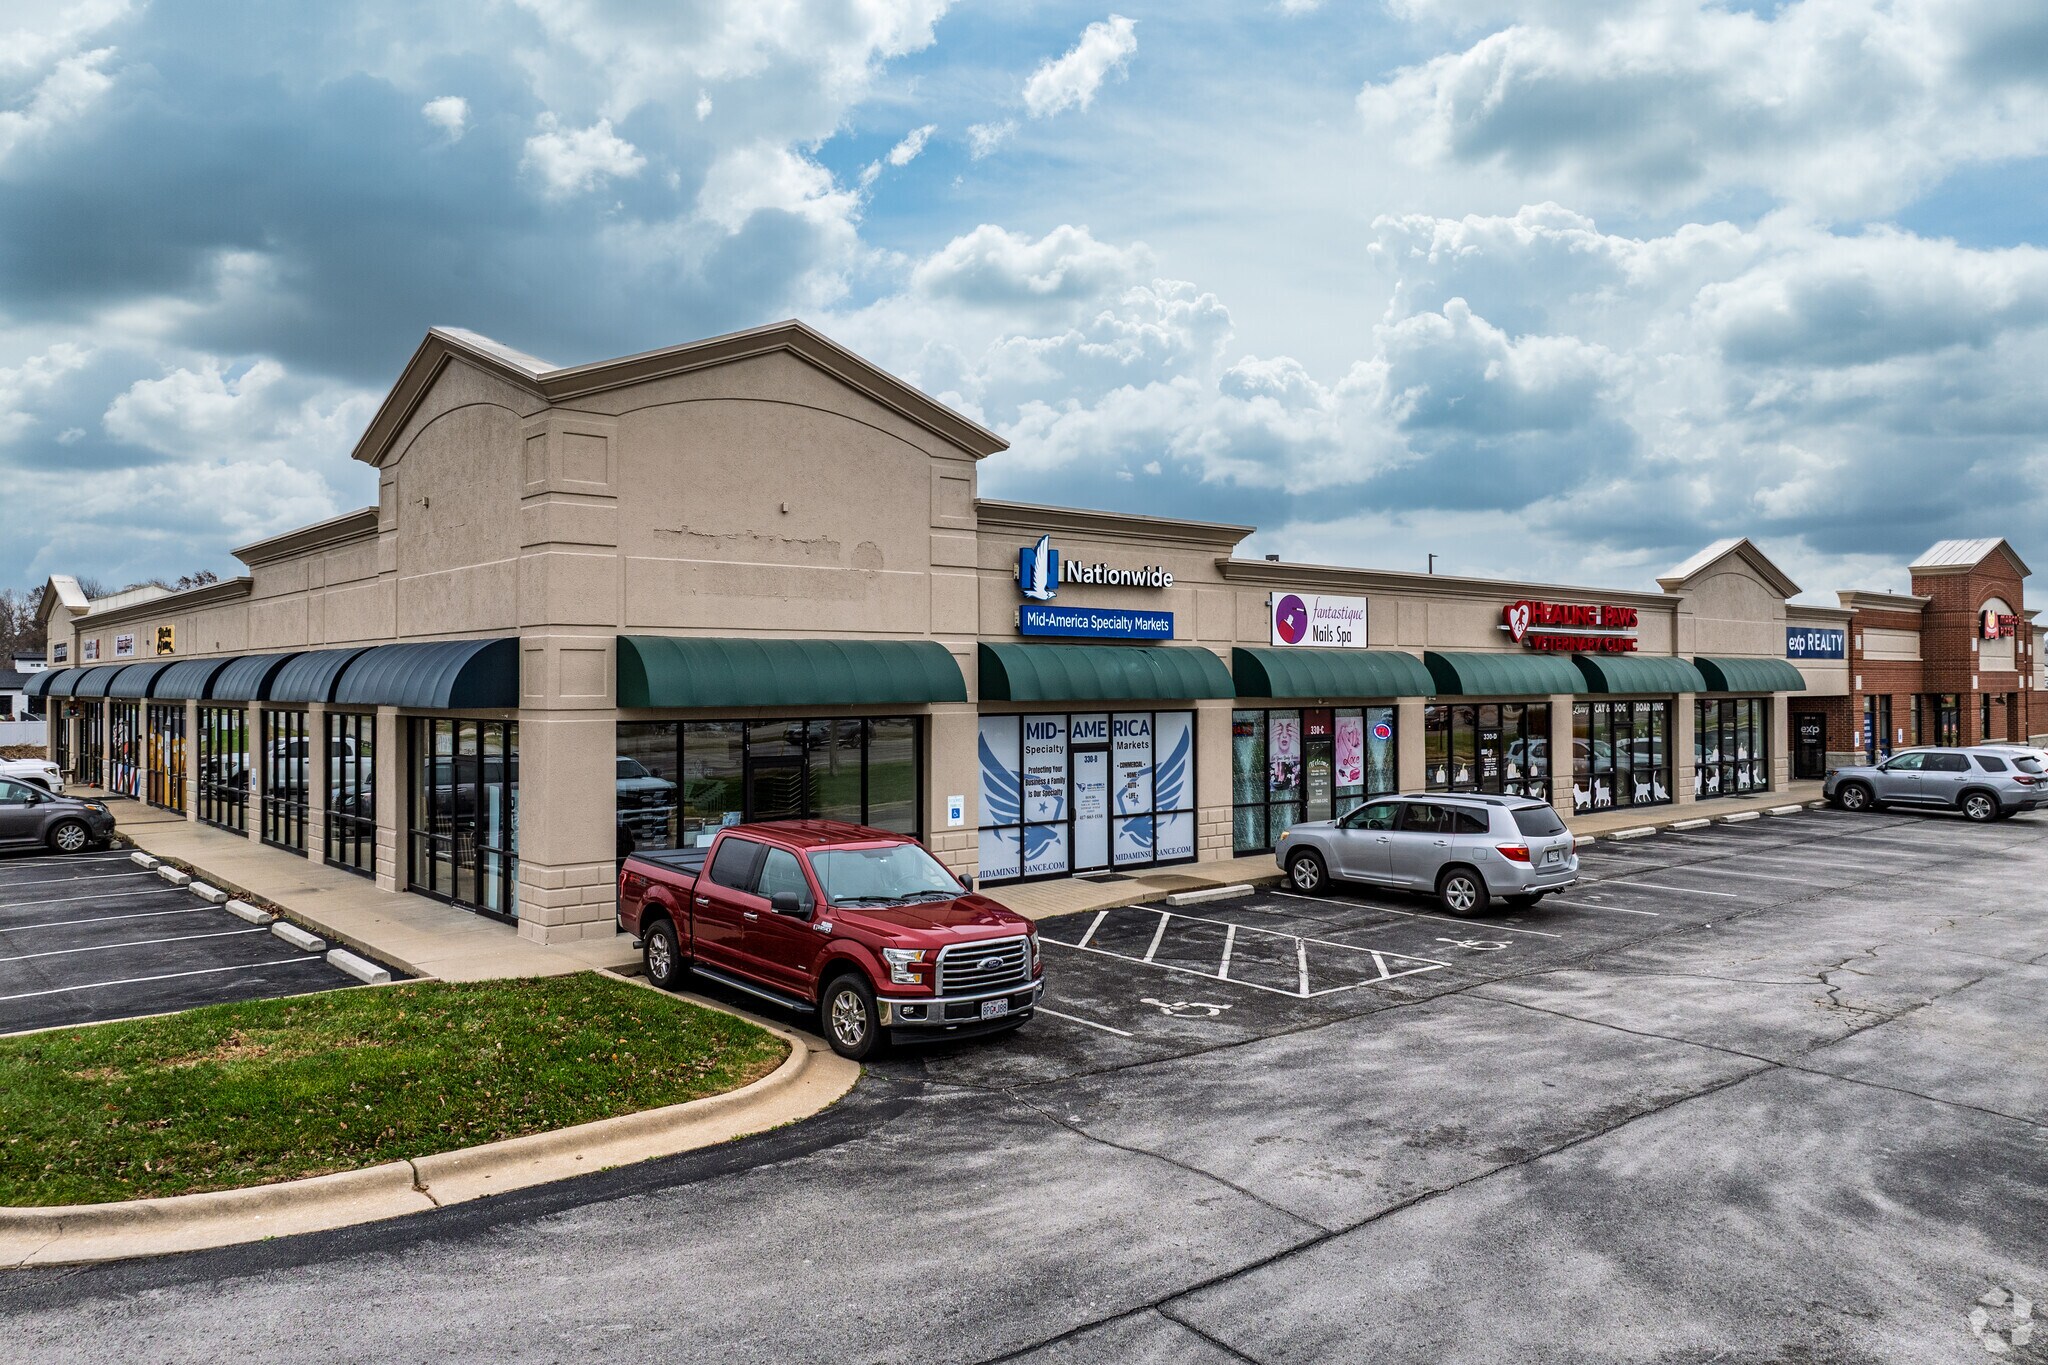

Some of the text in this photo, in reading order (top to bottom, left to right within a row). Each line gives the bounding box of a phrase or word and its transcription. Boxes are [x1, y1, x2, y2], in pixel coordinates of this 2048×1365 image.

[1066, 560, 1174, 587] Nationwide
[1311, 596, 1364, 627] fantastique
[1529, 601, 1638, 627] HEALING PAWS
[1027, 612, 1169, 632] Mid-America Specialty Markets
[1312, 623, 1352, 646] Nails Spa
[1529, 636, 1638, 652] VETERINARY CLINIC
[1789, 633, 1843, 655] exp REALTY
[1594, 703, 1605, 713] CAT
[1606, 704, 1610, 713] &
[1614, 703, 1626, 712] DOG
[1801, 725, 1820, 735] exp
[1026, 743, 1064, 755] Specialty
[1116, 740, 1149, 750] Markets
[1028, 766, 1052, 774] Protecting
[1025, 778, 1046, 786] Business
[1051, 776, 1065, 785] Family
[1042, 789, 1063, 798] Specialty
[1115, 846, 1191, 861] MIDAMINSURANCE.COM
[978, 861, 1065, 878] MIDAMINSURANCE.COM
